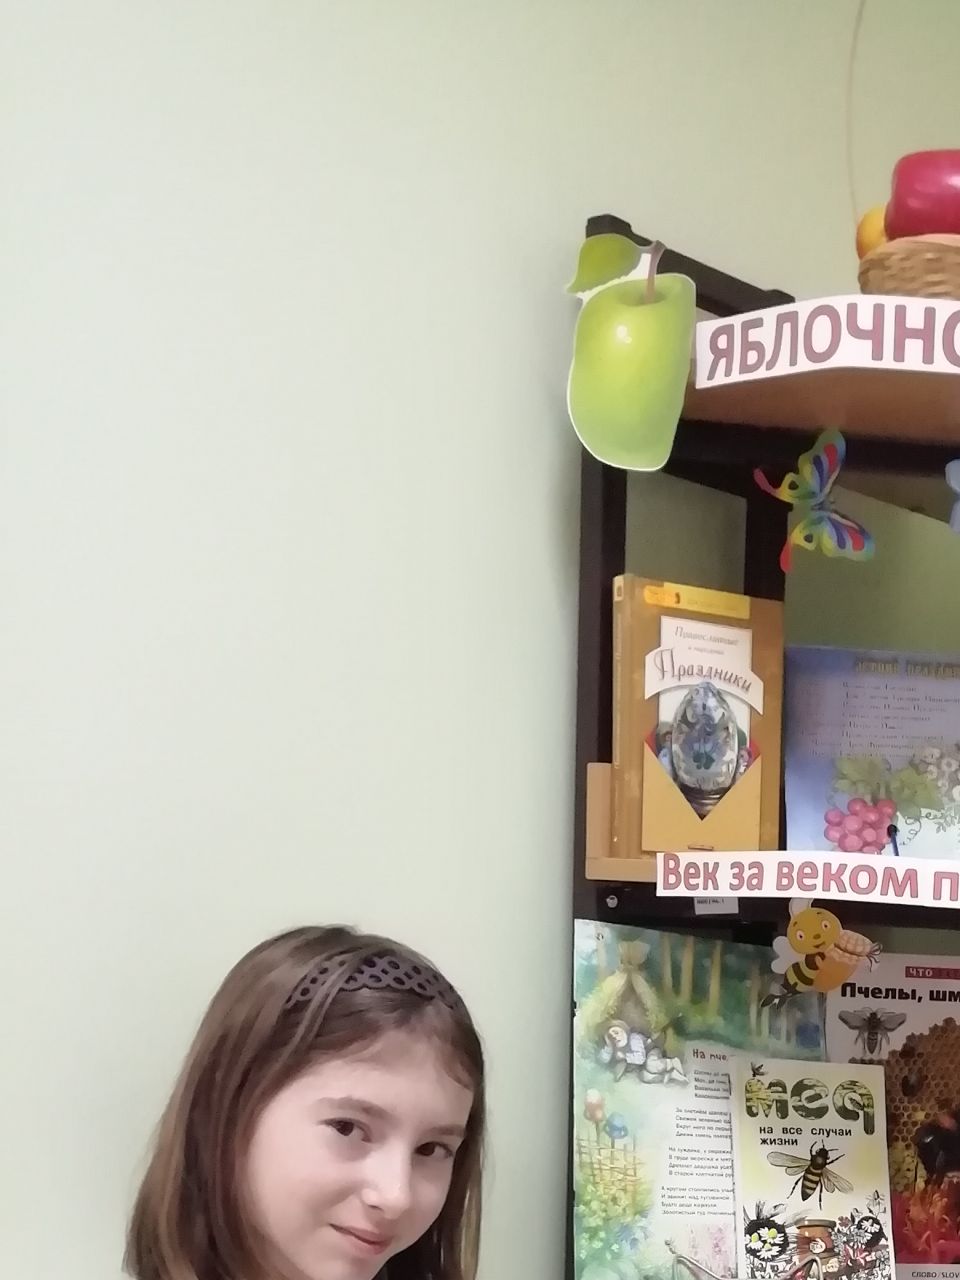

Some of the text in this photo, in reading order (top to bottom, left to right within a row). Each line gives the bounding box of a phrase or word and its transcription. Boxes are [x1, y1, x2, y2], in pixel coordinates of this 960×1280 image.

[653, 648, 753, 693] Праздники
[662, 853, 720, 892] Век
[729, 860, 765, 892] за
[775, 860, 918, 899] веком
[909, 968, 933, 977] ЧТО
[841, 982, 923, 1004] Пчелы,
[693, 1049, 729, 1062] На пче
[759, 1126, 852, 1138] на все случаи
[760, 1137, 798, 1146] жизни
